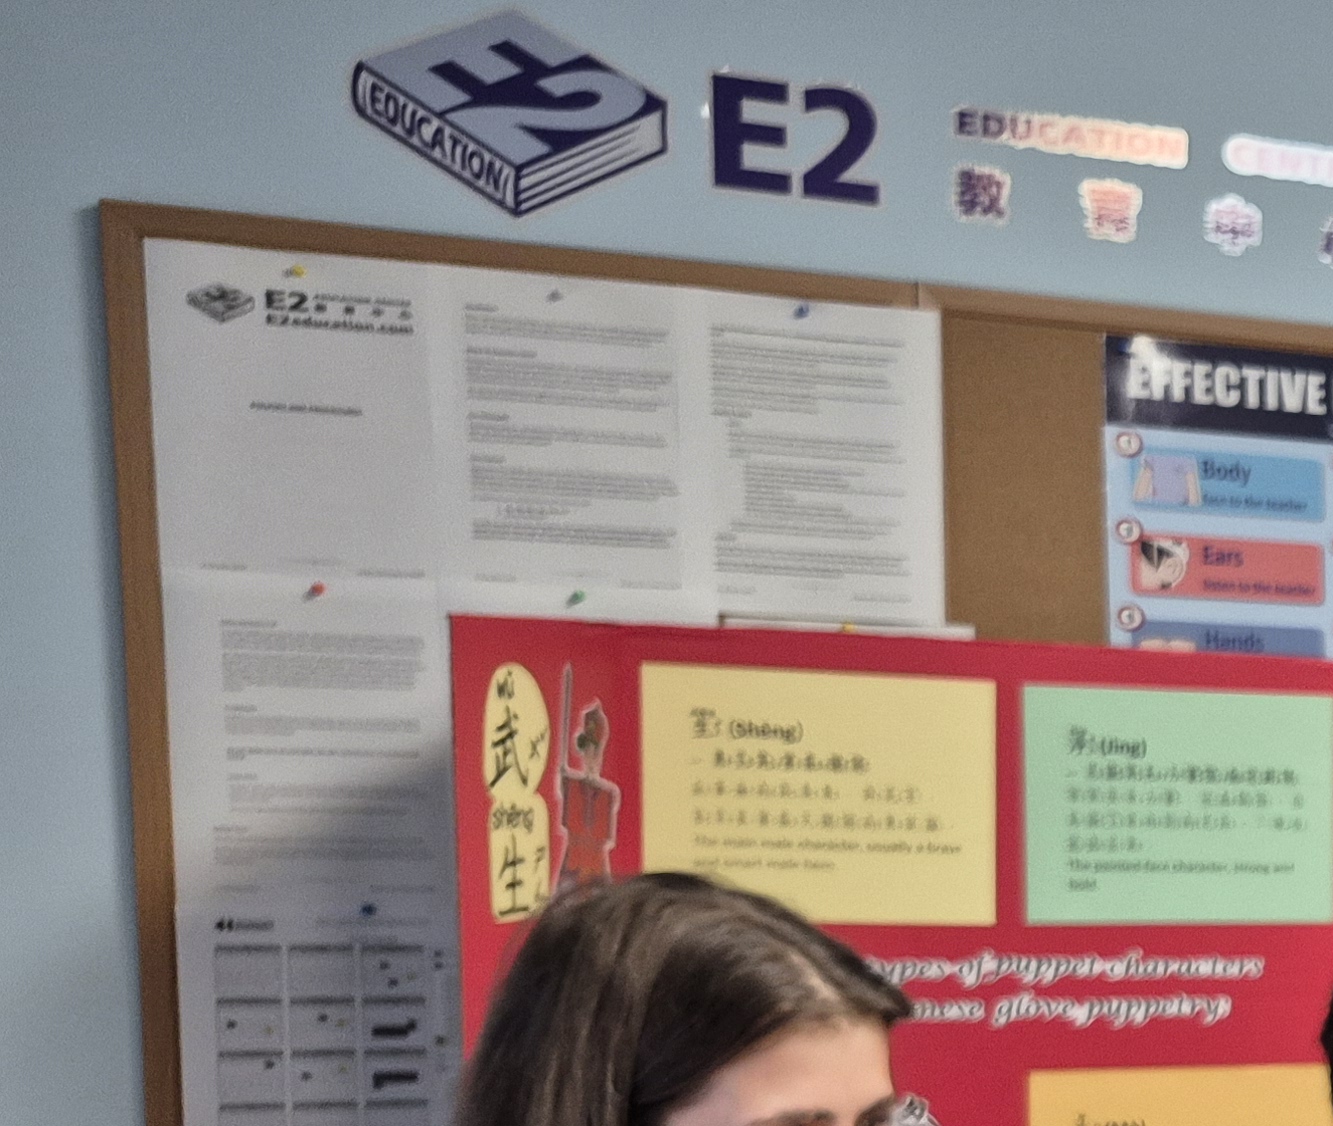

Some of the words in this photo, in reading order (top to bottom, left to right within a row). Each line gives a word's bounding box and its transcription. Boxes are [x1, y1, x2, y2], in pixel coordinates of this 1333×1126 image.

[369, 81, 503, 193] EDUCATION
[711, 74, 880, 206] E2
[955, 108, 1185, 161] EDUCATION
[265, 288, 310, 313] E2
[1127, 357, 1328, 416] EFFECTIVE
[1202, 460, 1251, 487] Body
[1203, 545, 1244, 567] Ears
[489, 704, 530, 788] 武
[866, 955, 947, 986] ypes
[984, 952, 1101, 986] puppet
[1107, 946, 1263, 979] characters
[993, 988, 1076, 1027] glove
